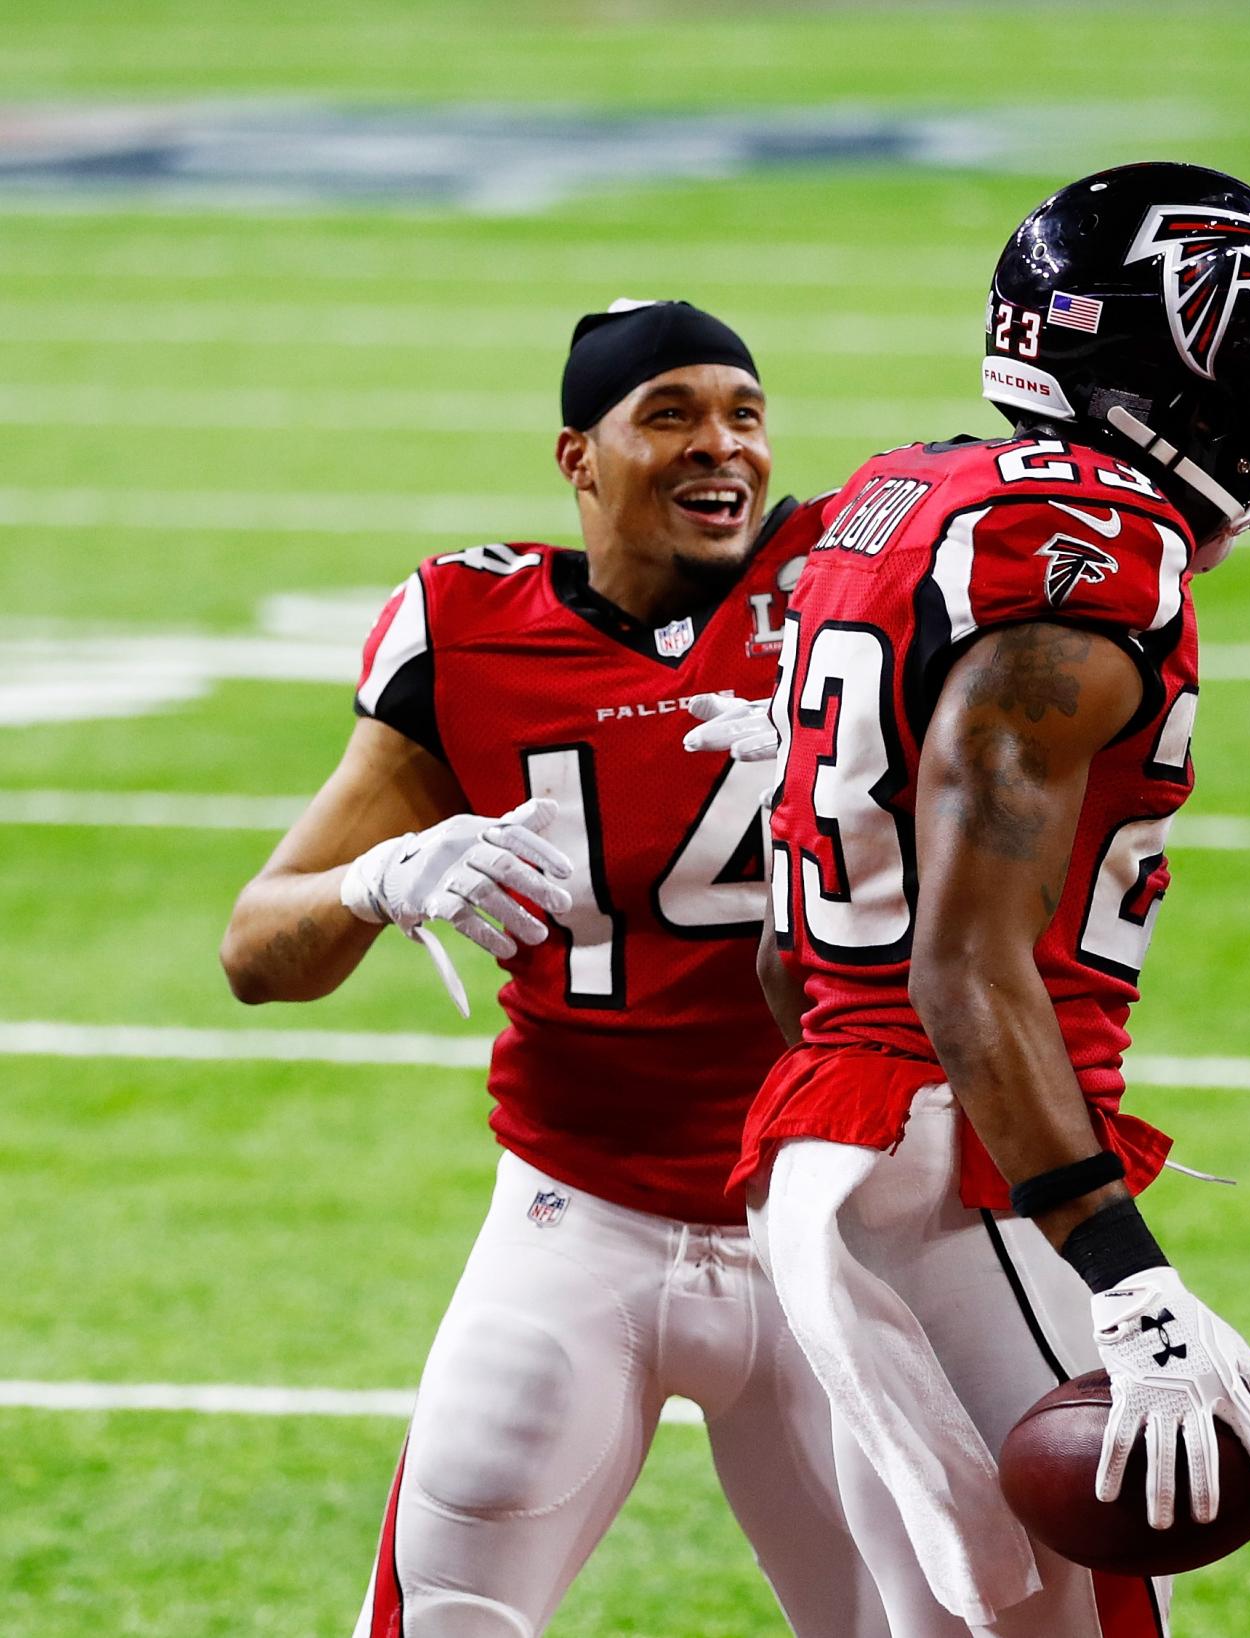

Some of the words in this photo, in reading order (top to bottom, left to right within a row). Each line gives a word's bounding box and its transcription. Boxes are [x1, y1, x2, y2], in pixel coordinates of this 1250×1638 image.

[993, 302, 1042, 359] 23
[984, 368, 1051, 396] FALCONS
[995, 438, 1169, 502] 23
[519, 741, 773, 1010] 14
